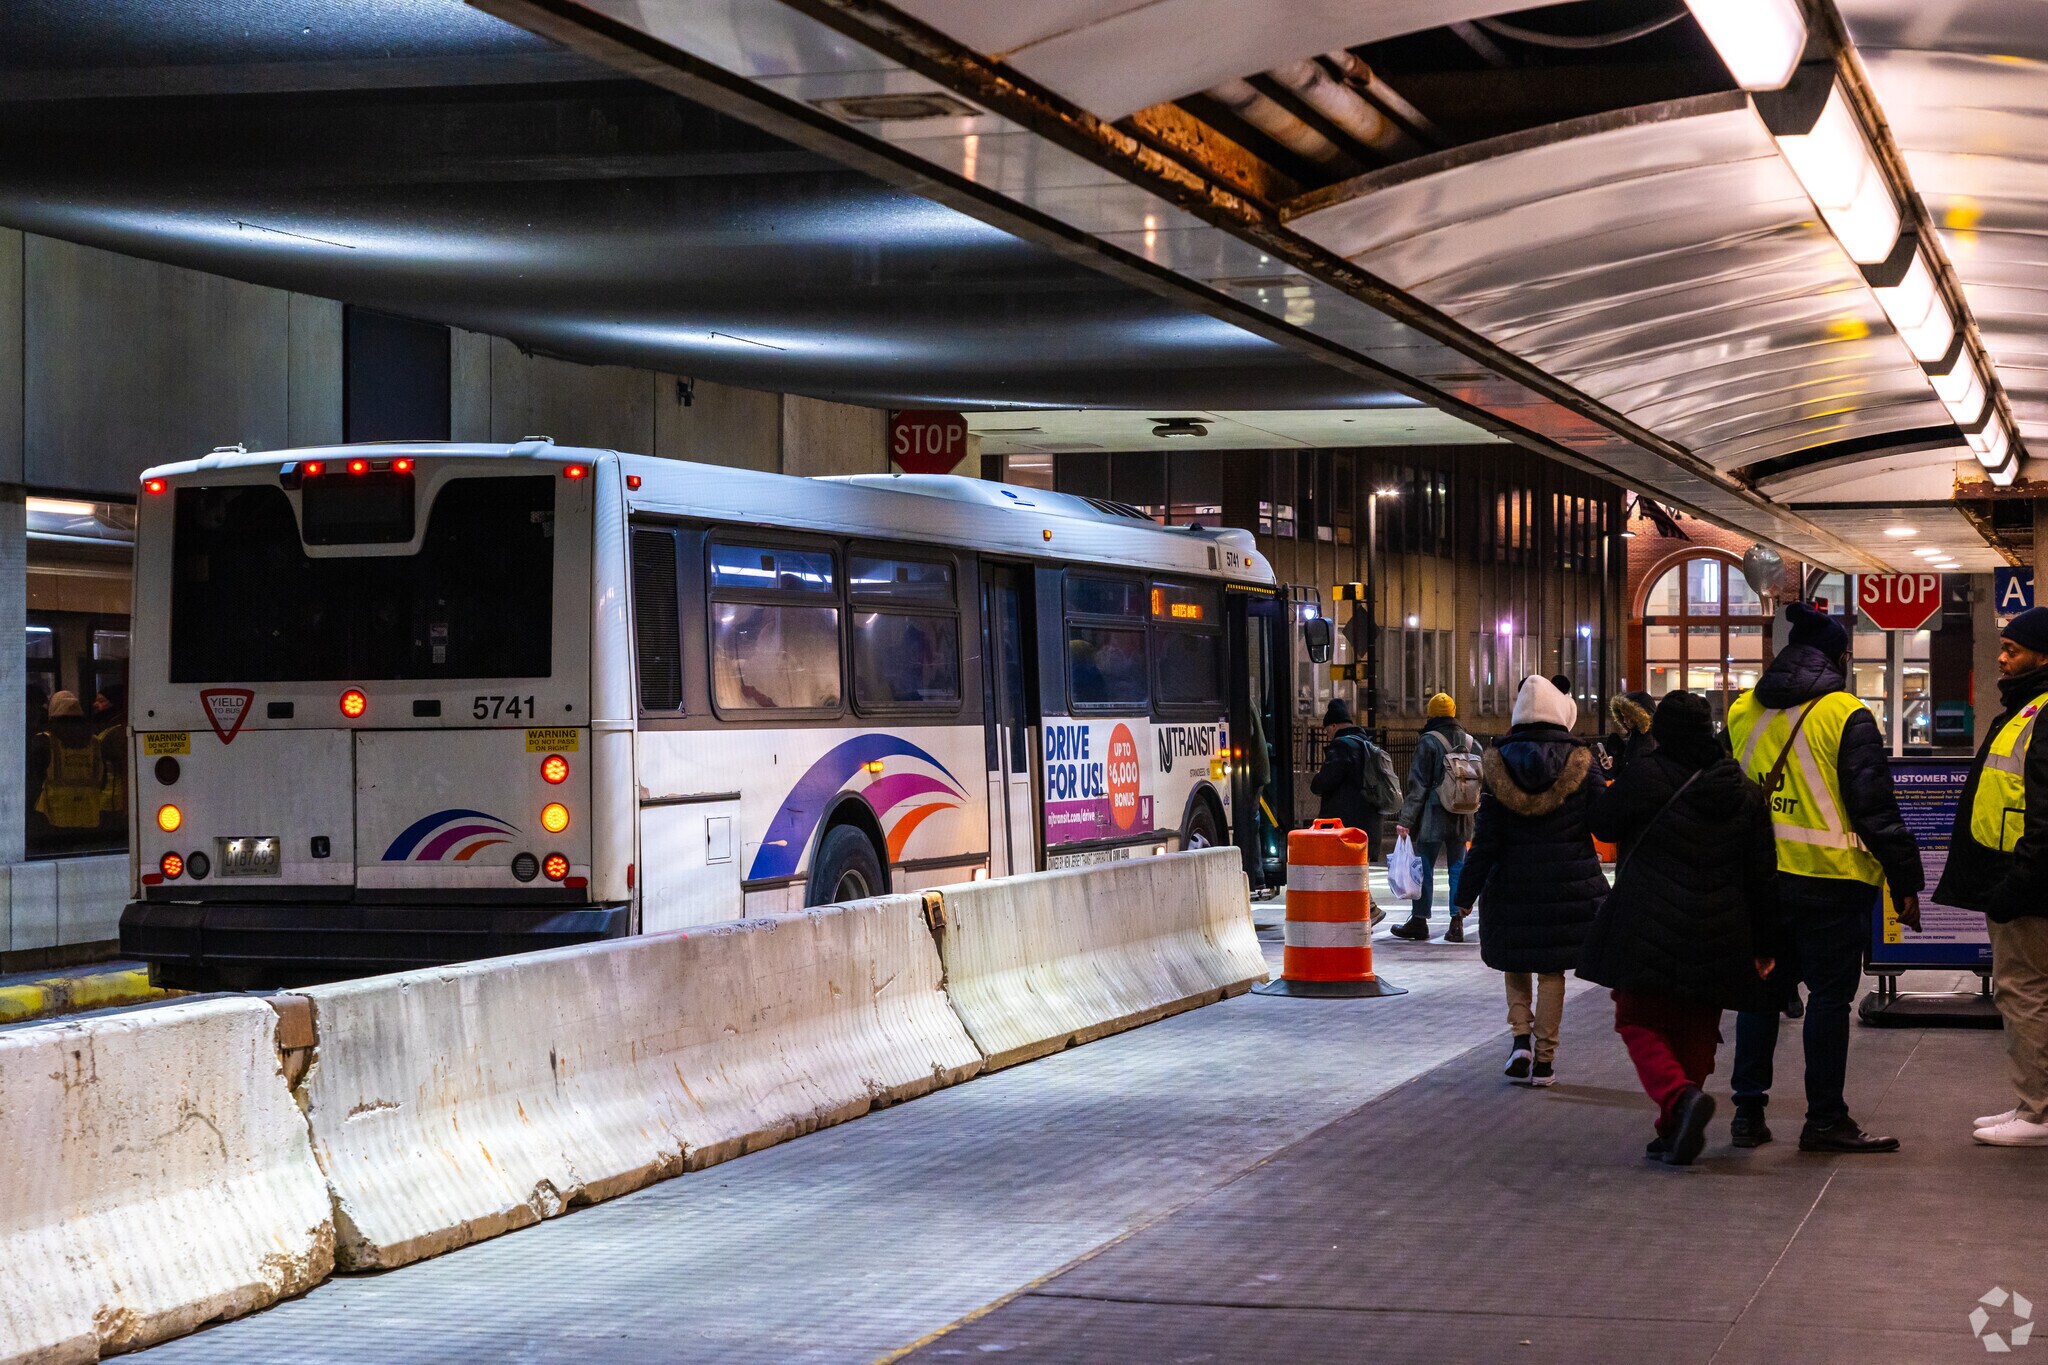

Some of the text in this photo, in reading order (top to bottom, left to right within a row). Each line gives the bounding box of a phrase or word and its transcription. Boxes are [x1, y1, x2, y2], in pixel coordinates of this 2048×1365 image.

[894, 424, 962, 455] STOP
[1226, 552, 1239, 568] 5741
[1863, 574, 1936, 604] STOP
[210, 698, 244, 707] YIELD
[473, 696, 534, 720] 5741
[147, 734, 187, 742] WARNING
[528, 730, 576, 739] WARNING
[1046, 726, 1089, 761] DRIVE
[1114, 742, 1131, 757] UP TO
[1048, 763, 1103, 800] FOR US!
[1109, 762, 1137, 787] $6,000
[1893, 774, 1968, 783] USTOMER NO
[1114, 792, 1135, 808] BONUS
[1048, 808, 1095, 828] njtransit.com/drive
